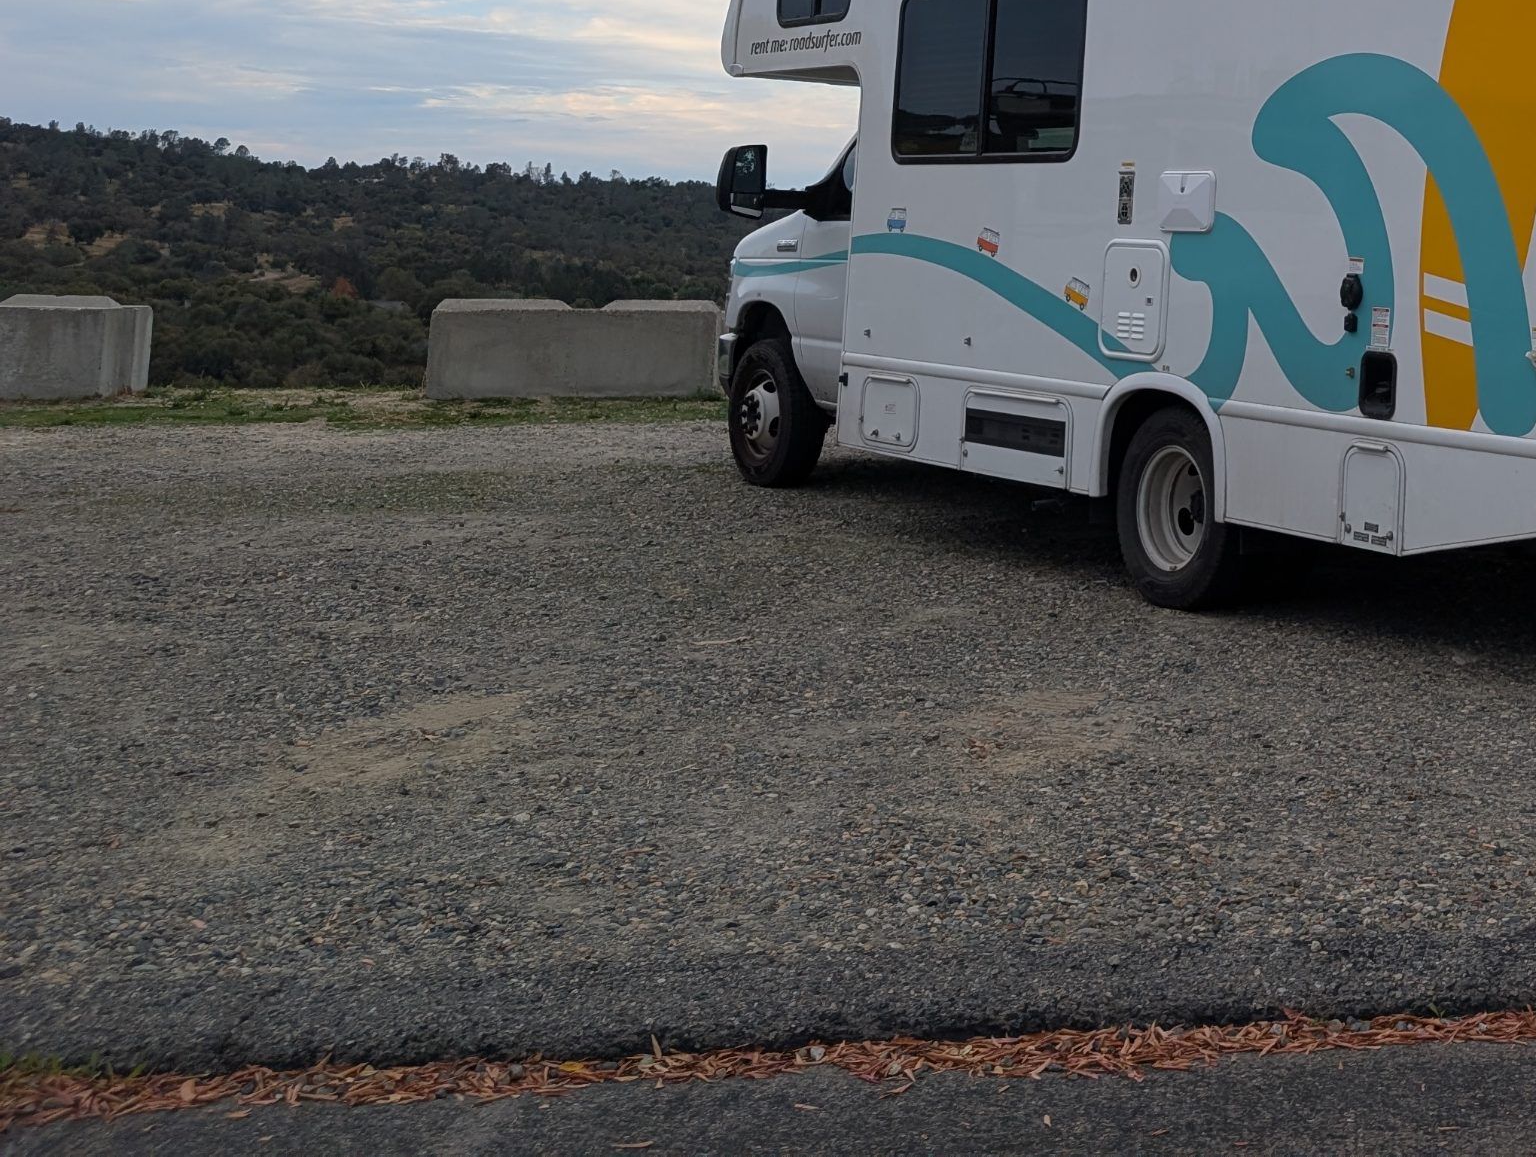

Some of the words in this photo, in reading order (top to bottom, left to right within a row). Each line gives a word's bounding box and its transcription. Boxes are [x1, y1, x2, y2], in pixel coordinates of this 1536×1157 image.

[750, 37, 770, 56] rent
[770, 38, 788, 54] me:
[788, 28, 862, 53] roadsurfer.com
